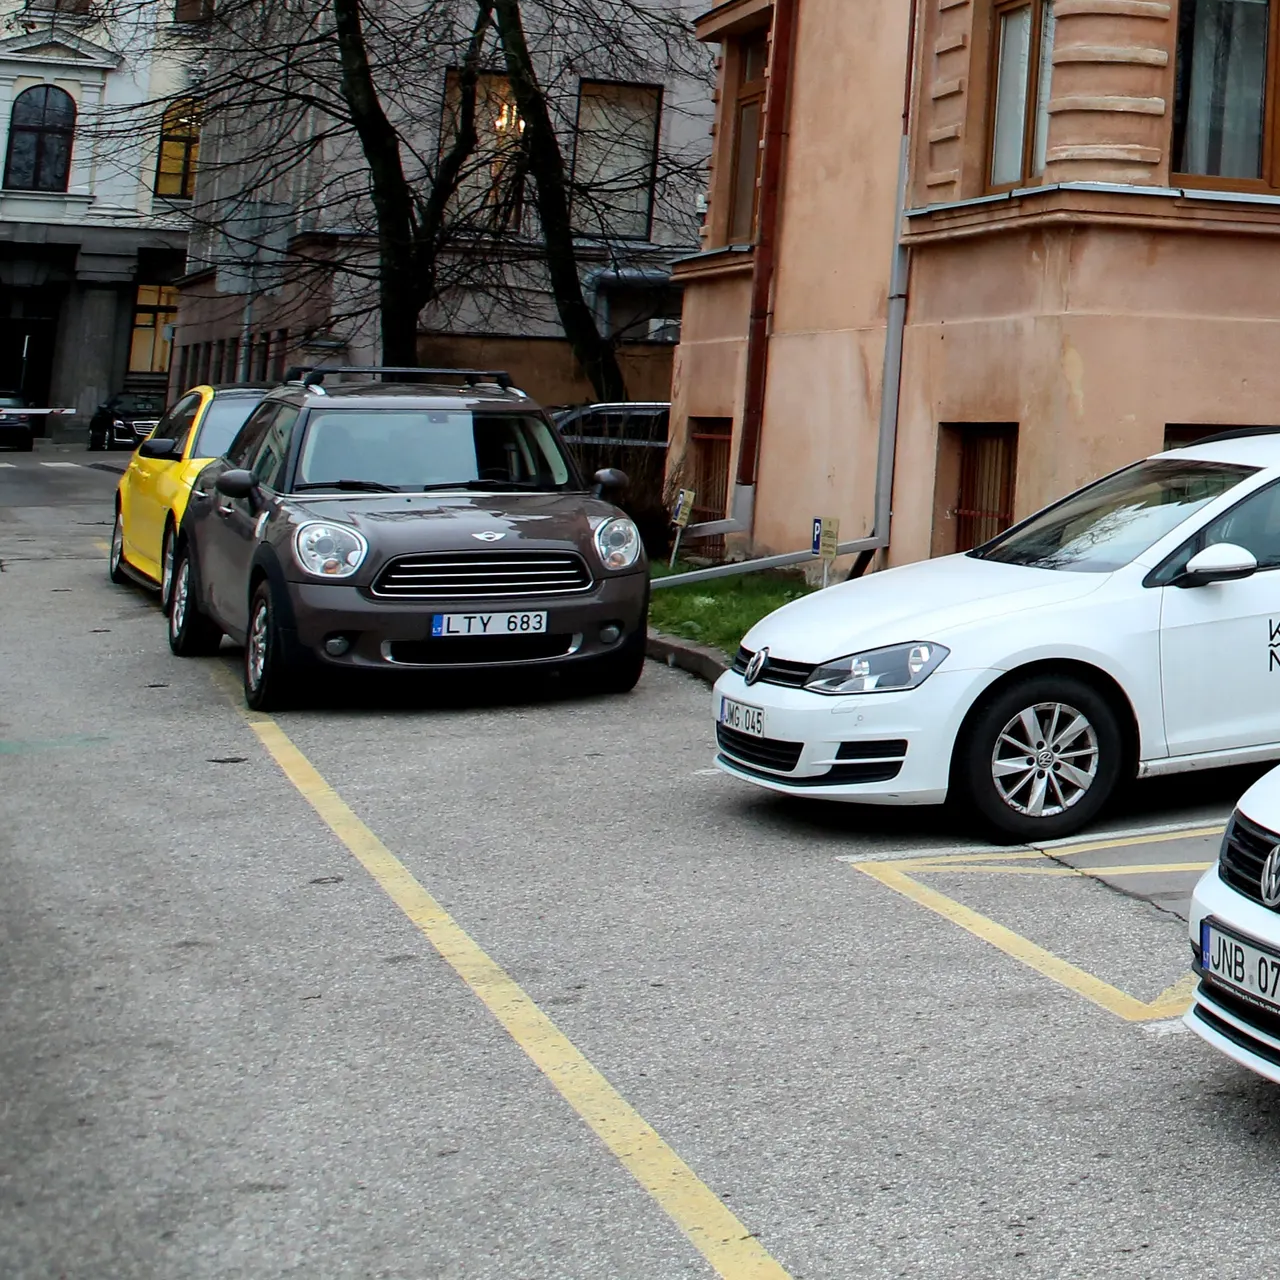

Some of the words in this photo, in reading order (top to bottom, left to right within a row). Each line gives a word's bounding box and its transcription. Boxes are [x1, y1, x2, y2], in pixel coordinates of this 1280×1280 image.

[446, 615, 492, 634] LTY
[507, 614, 543, 632] 683
[745, 709, 762, 734] 045
[1211, 936, 1245, 982] JNB
